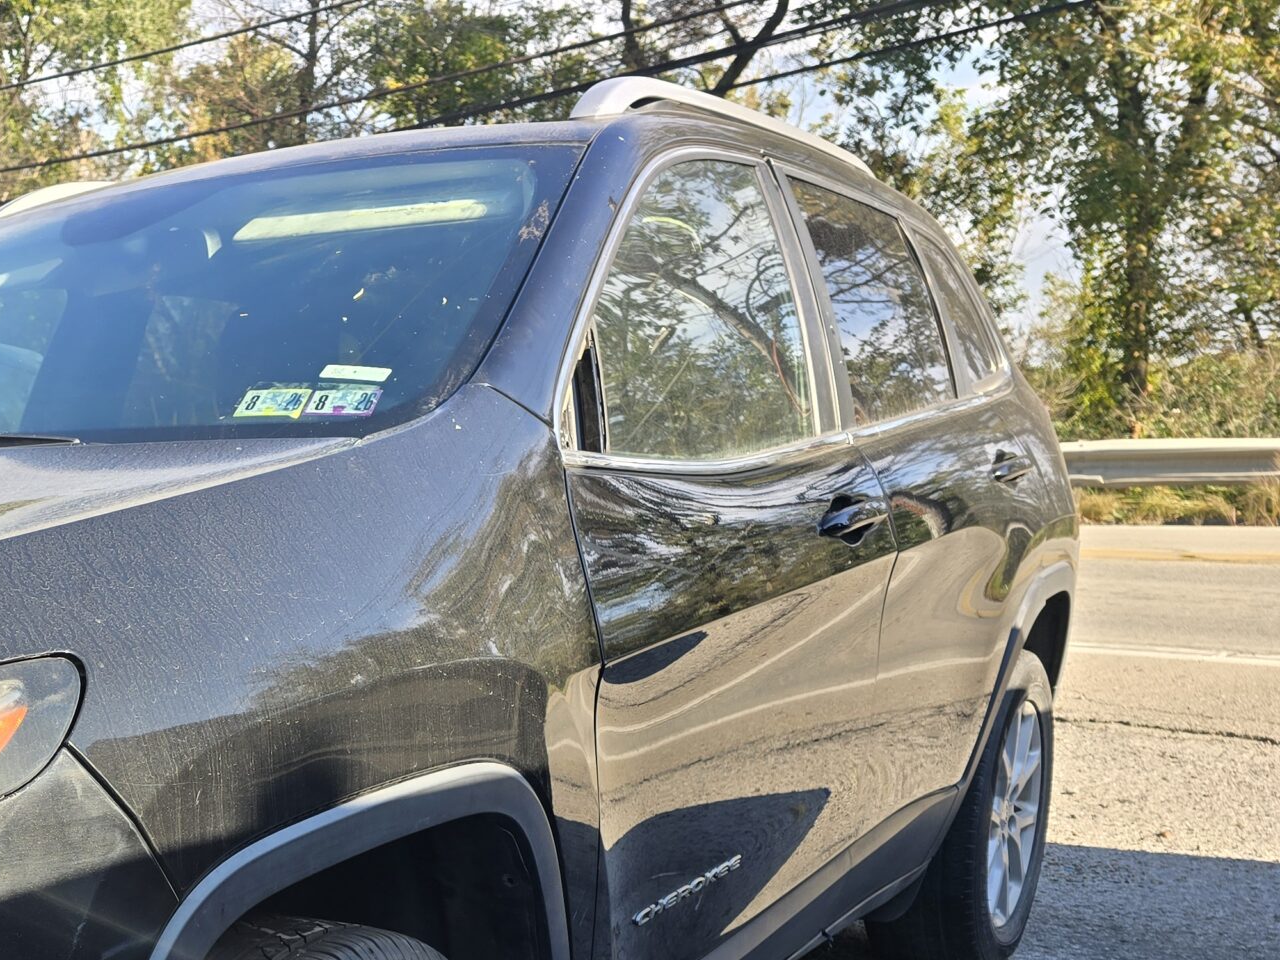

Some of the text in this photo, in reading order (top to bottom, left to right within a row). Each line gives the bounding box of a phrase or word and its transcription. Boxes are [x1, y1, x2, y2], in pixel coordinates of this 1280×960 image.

[245, 395, 261, 411] 8
[314, 392, 377, 411] 8 26
[631, 854, 742, 926] CHEROKEE
